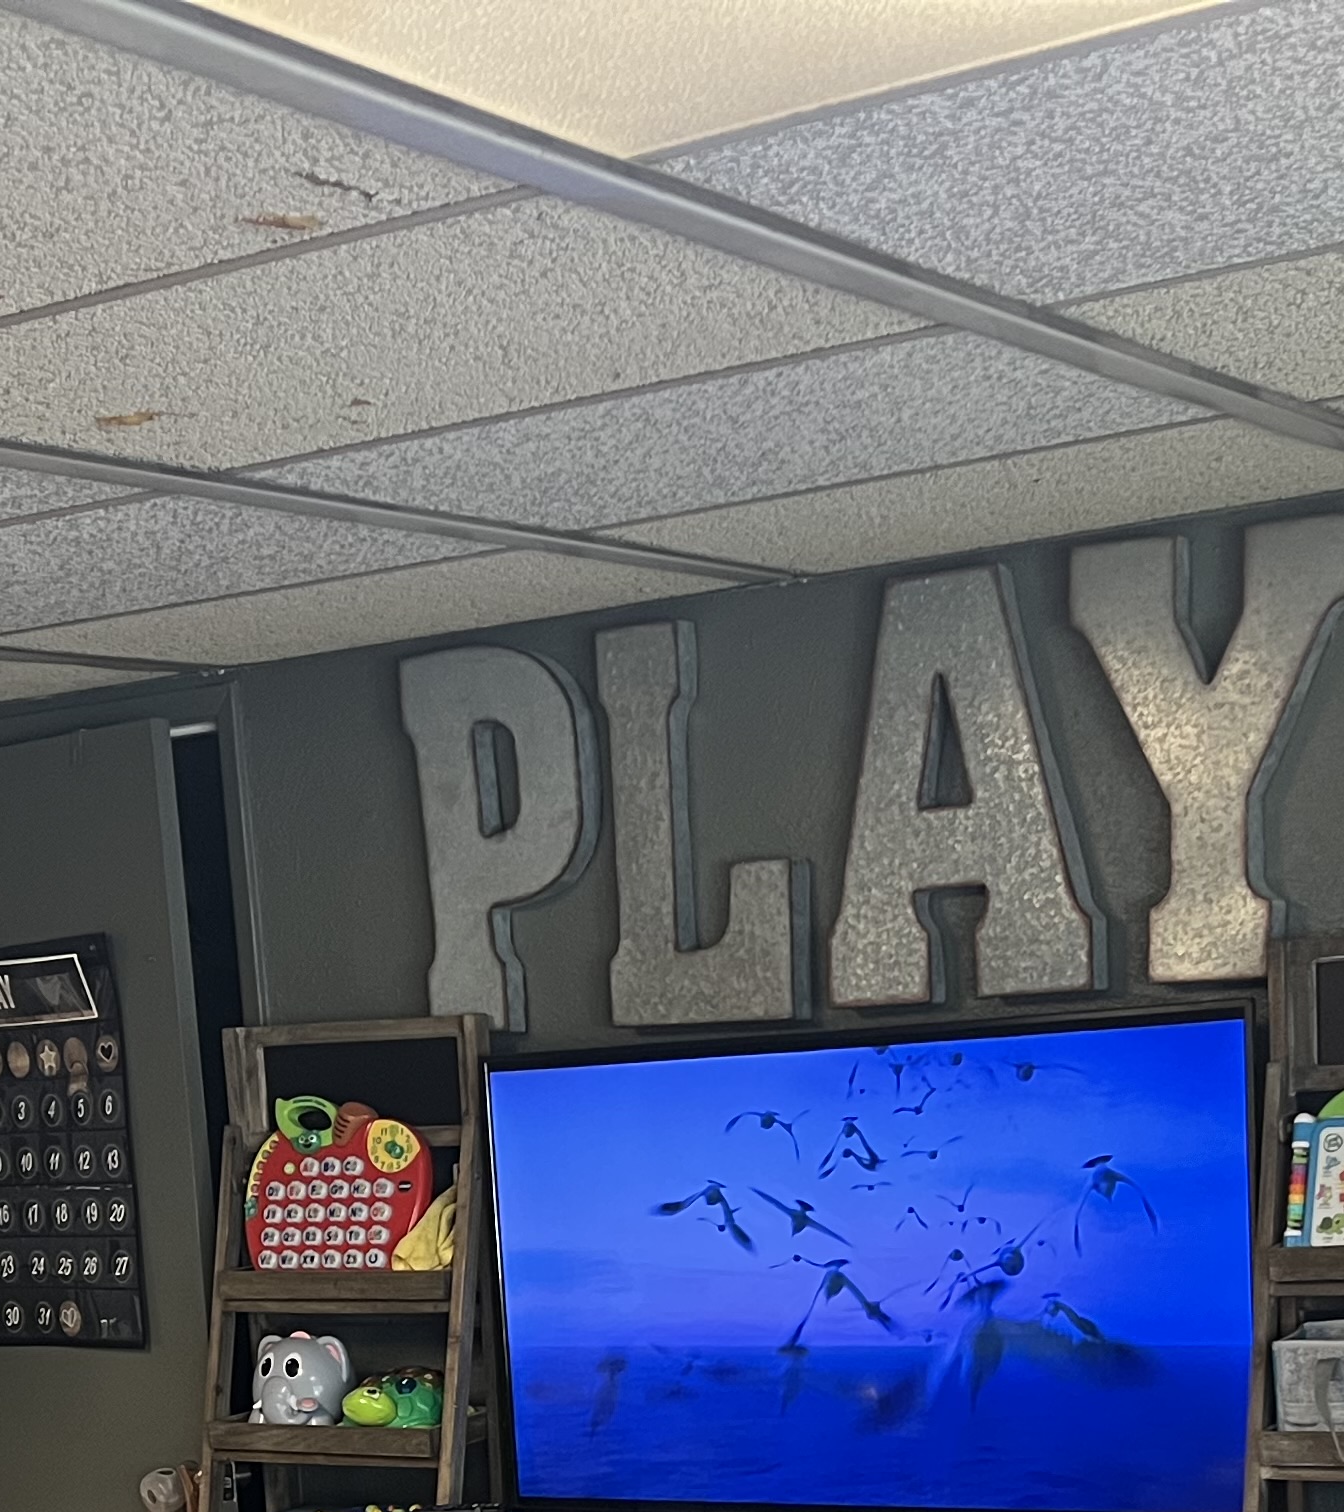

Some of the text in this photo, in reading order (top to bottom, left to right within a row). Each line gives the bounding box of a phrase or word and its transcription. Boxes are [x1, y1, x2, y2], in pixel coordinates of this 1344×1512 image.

[20, 1149, 119, 1172] 10 11 12 13
[28, 1203, 38, 1225] 17
[56, 1203, 68, 1224] 18
[86, 1202, 98, 1224] 19
[109, 1203, 125, 1223] 20
[1, 1255, 14, 1278] 23
[31, 1257, 45, 1275] 24
[58, 1257, 73, 1276] 25
[83, 1257, 97, 1276] 26
[115, 1256, 129, 1276] 27
[6, 1307, 20, 1327] 30
[38, 1308, 51, 1325] 31
